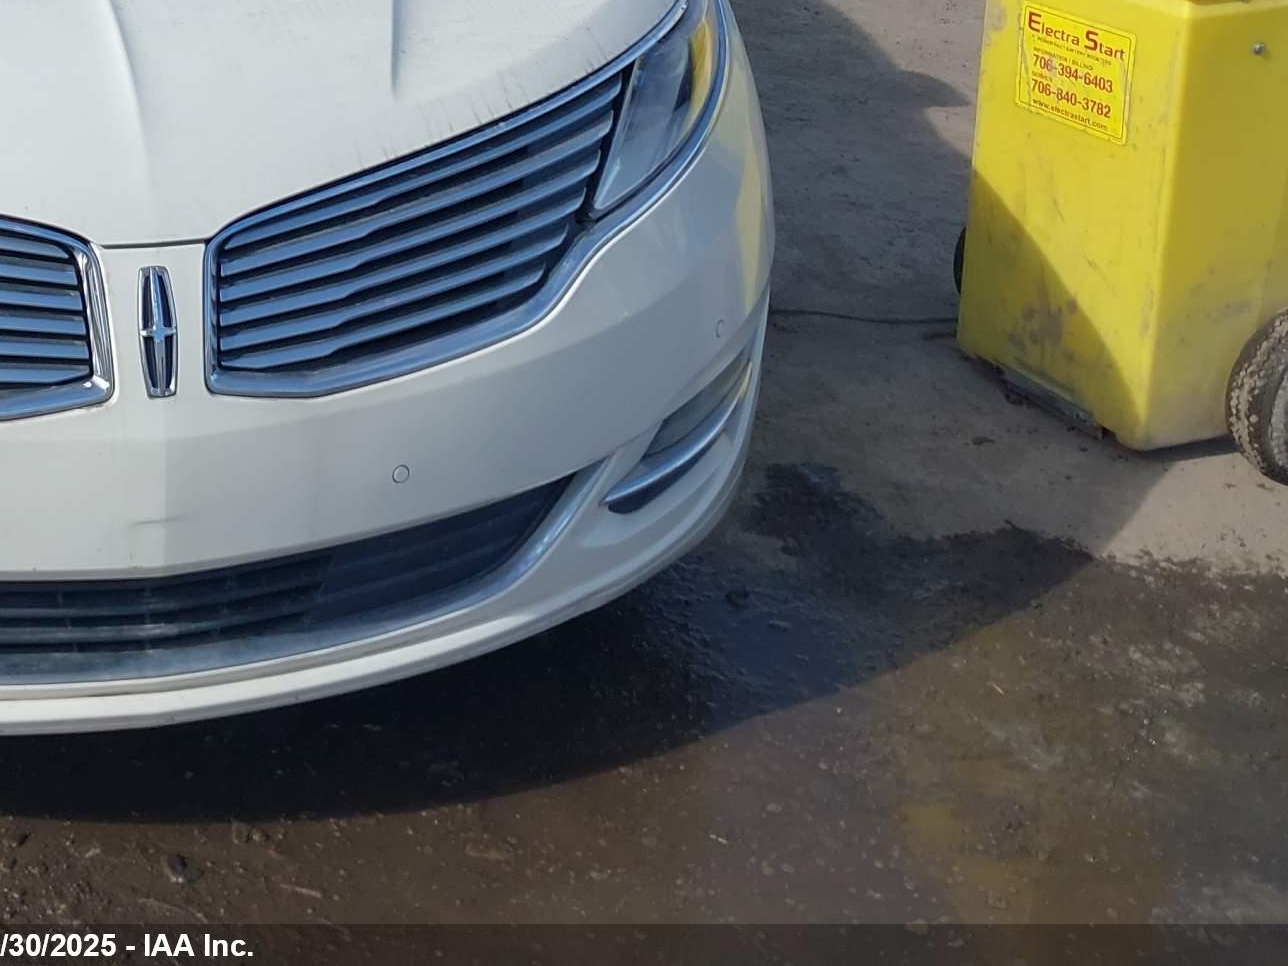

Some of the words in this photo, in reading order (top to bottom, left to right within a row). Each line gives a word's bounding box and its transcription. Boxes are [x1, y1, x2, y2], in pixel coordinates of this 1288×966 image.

[1028, 10, 1080, 46] Electra
[1084, 29, 1125, 61] Start
[1033, 53, 1113, 93] 706-394-6403
[1031, 78, 1111, 118] 706-840-3782
[1032, 99, 1108, 131] www.electrastart.com
